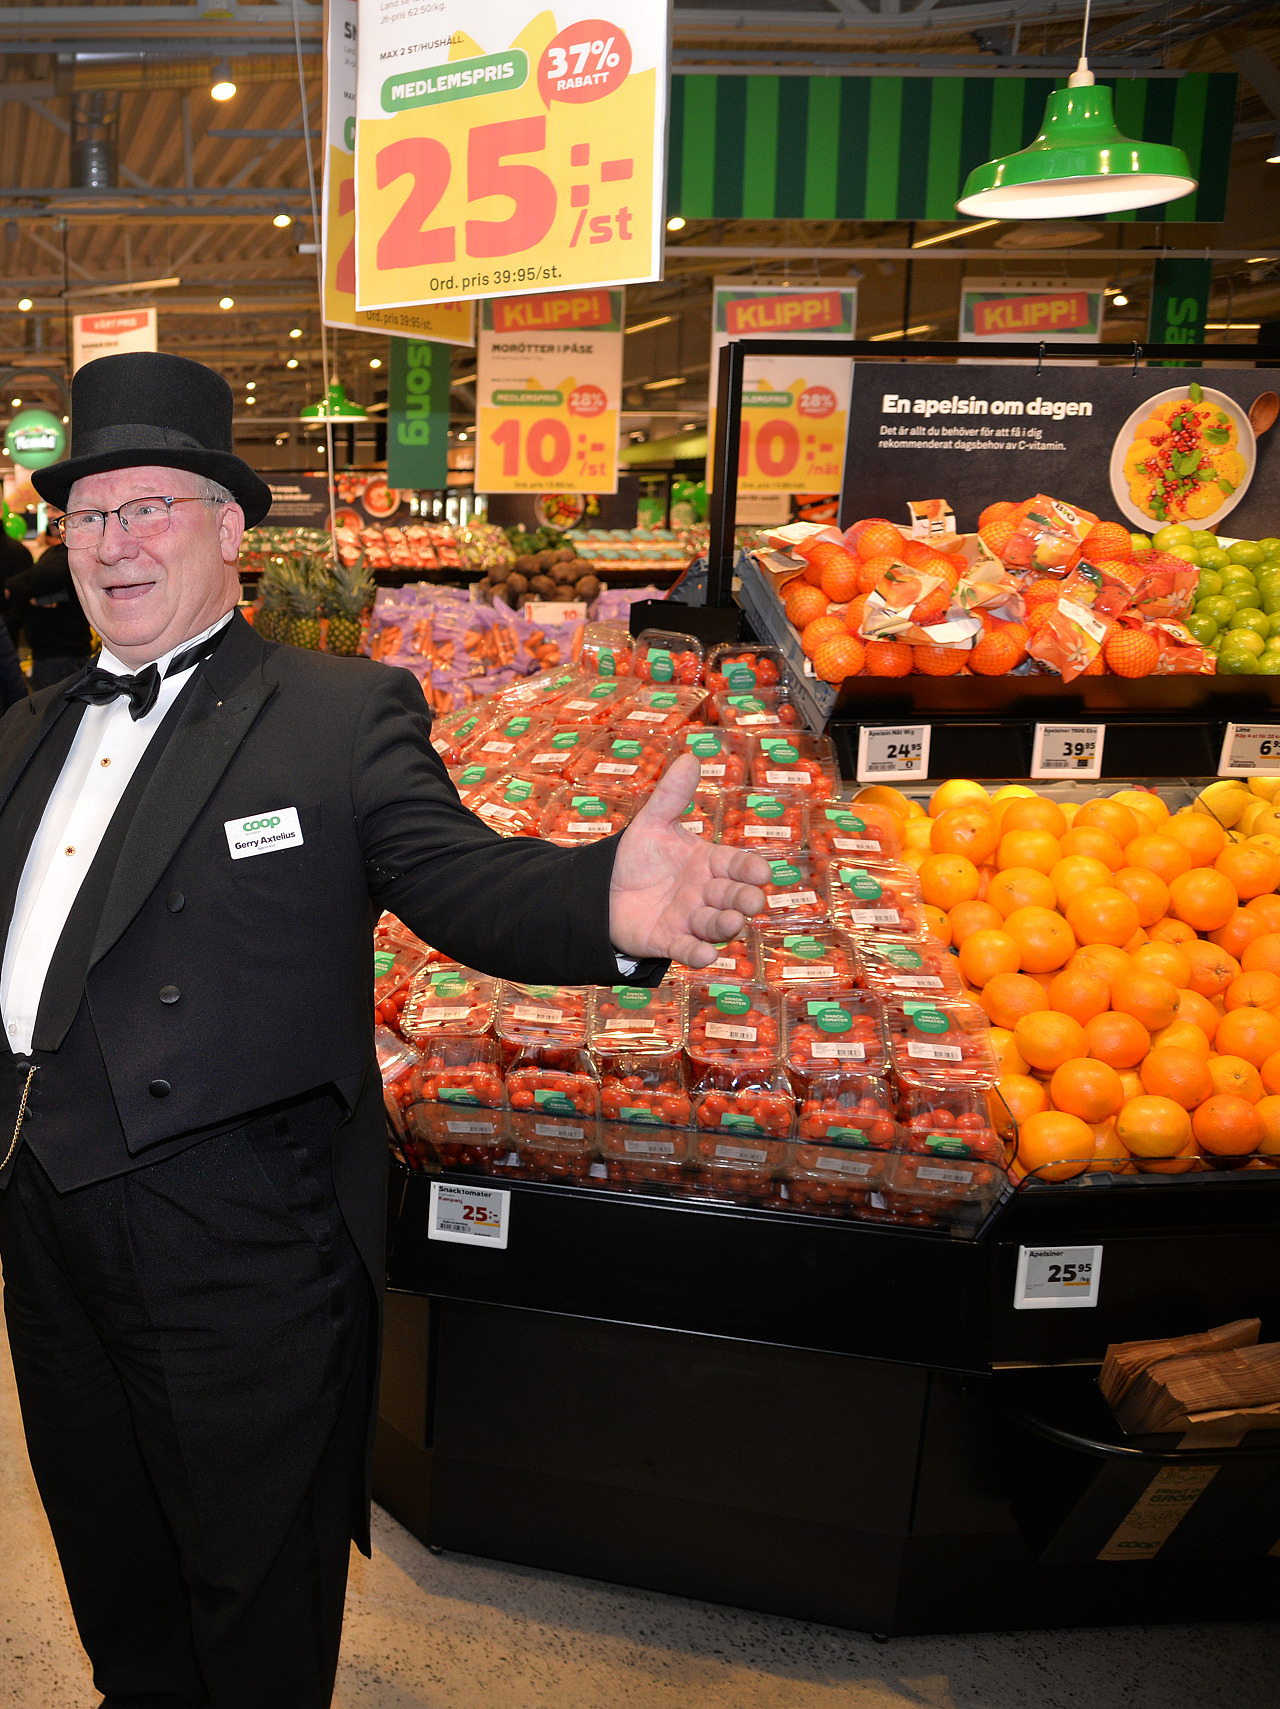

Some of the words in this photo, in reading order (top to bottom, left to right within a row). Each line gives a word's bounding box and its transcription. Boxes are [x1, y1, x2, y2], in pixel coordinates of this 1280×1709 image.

[380, 48, 398, 60] MAX
[400, 48, 406, 56] 2
[407, 35, 465, 54] ST/HUSHÅLL.
[547, 37, 619, 79] 37%
[391, 62, 514, 101] MEDLEMSPRIS
[556, 72, 609, 92] RABATT
[569, 206, 632, 248] /st
[429, 276, 459, 291] Ord.
[462, 273, 489, 297] pris
[493, 265, 563, 285] 39:95/st.
[384, 313, 399, 326] pris
[503, 296, 600, 328] KLIPP!
[735, 299, 831, 330] KLIPP!
[983, 300, 1078, 331] KLIPP!
[491, 342, 555, 354] MORÖTTER
[397, 338, 432, 446] song
[570, 392, 605, 407] 28%
[799, 393, 834, 408] 28%
[881, 394, 911, 414] En
[912, 395, 988, 418] apelsin
[990, 400, 1024, 415] om
[1026, 397, 1094, 421] dagen
[879, 425, 897, 436] Det
[898, 425, 909, 436] är
[909, 426, 926, 436] allt
[927, 426, 940, 437] du
[941, 426, 979, 437] behöver
[980, 426, 995, 437] för
[995, 427, 1010, 437] att
[1010, 426, 1020, 437] få
[1027, 427, 1043, 440] dig
[878, 438, 953, 449] rekommenderat
[954, 439, 1004, 451] dagsbehov
[1005, 441, 1018, 450] av
[1019, 440, 1067, 450] C-vitamin.
[242, 816, 281, 832] coop
[235, 839, 259, 850] Gerry
[260, 831, 296, 845] Axtelius
[438, 1185, 492, 1198] Snacktomater
[438, 1196, 463, 1204] Kampanj
[1029, 1251, 1064, 1259] Apelsiner
[1047, 1264, 1077, 1283] 25
[1078, 1263, 1092, 1272] 95
[1118, 1541, 1161, 1550] coop
